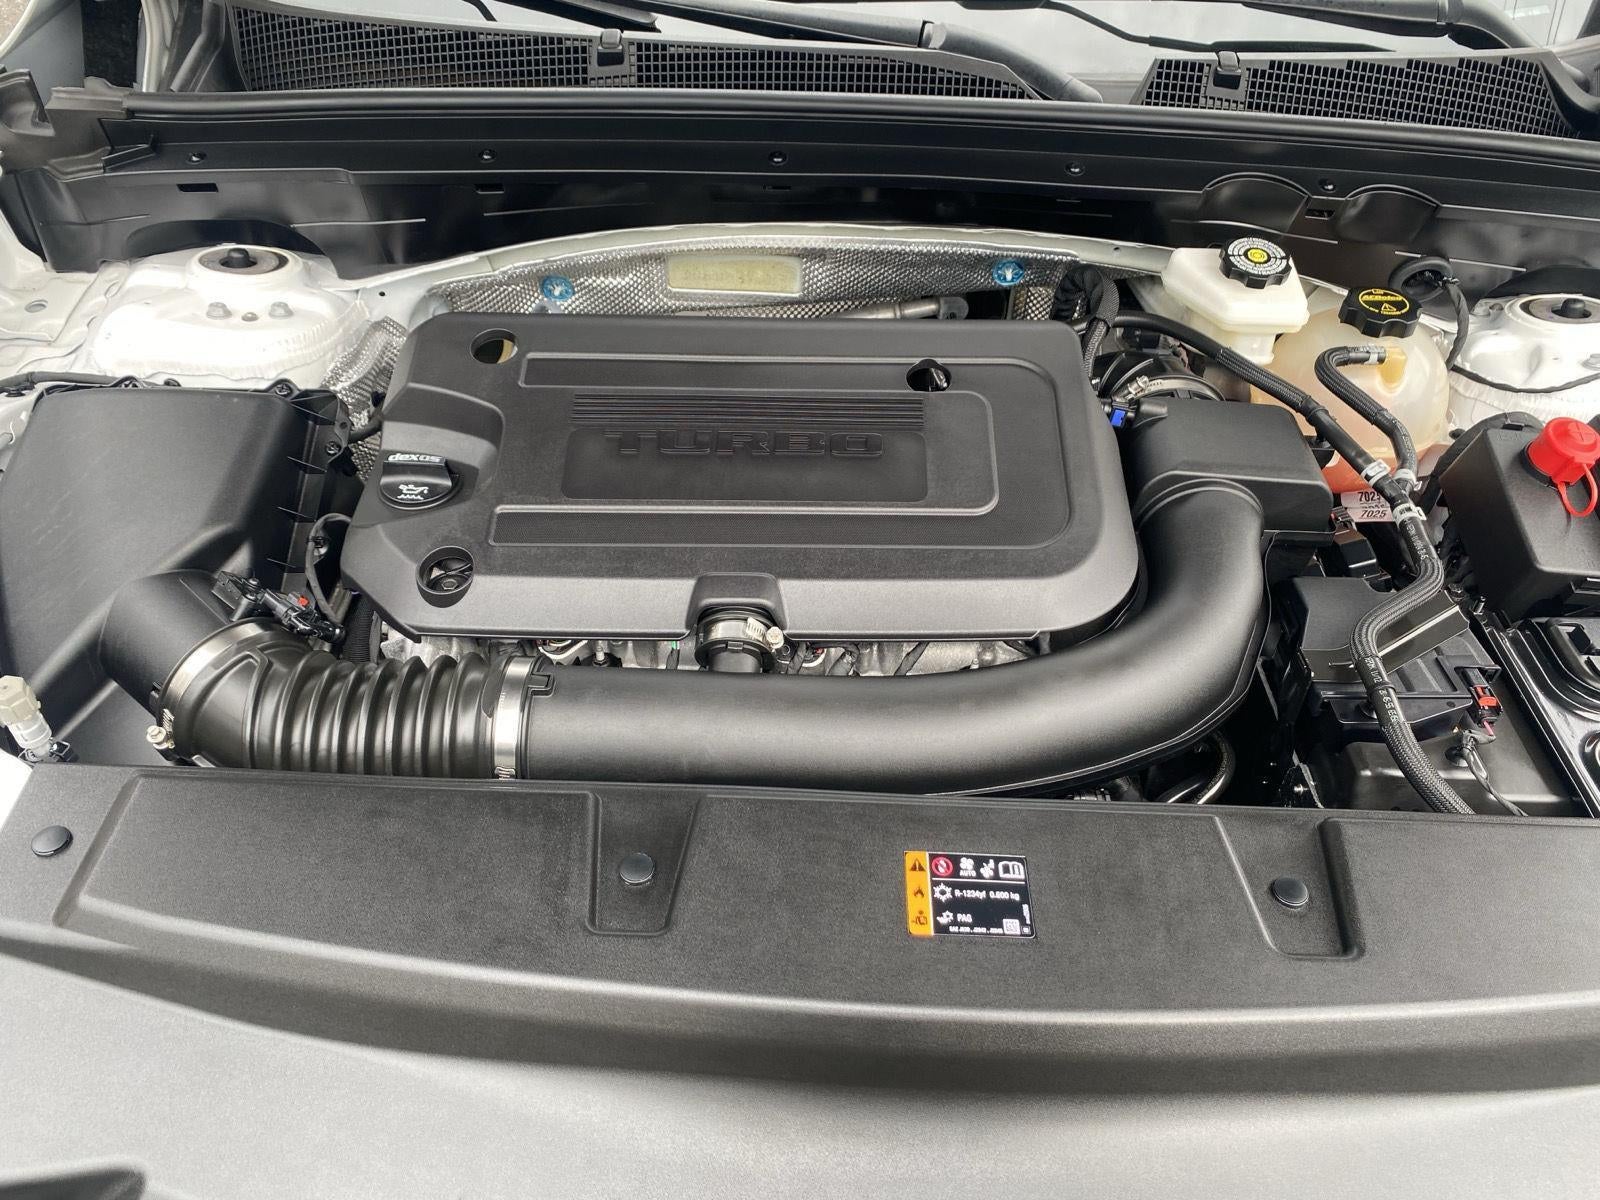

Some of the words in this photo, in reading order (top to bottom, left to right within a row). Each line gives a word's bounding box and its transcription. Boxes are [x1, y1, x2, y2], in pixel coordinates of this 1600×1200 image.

[603, 429, 884, 457] TURBO
[1361, 509, 1388, 518] 7025
[954, 889, 986, 899] R-1234yf
[1010, 892, 1020, 901] kg
